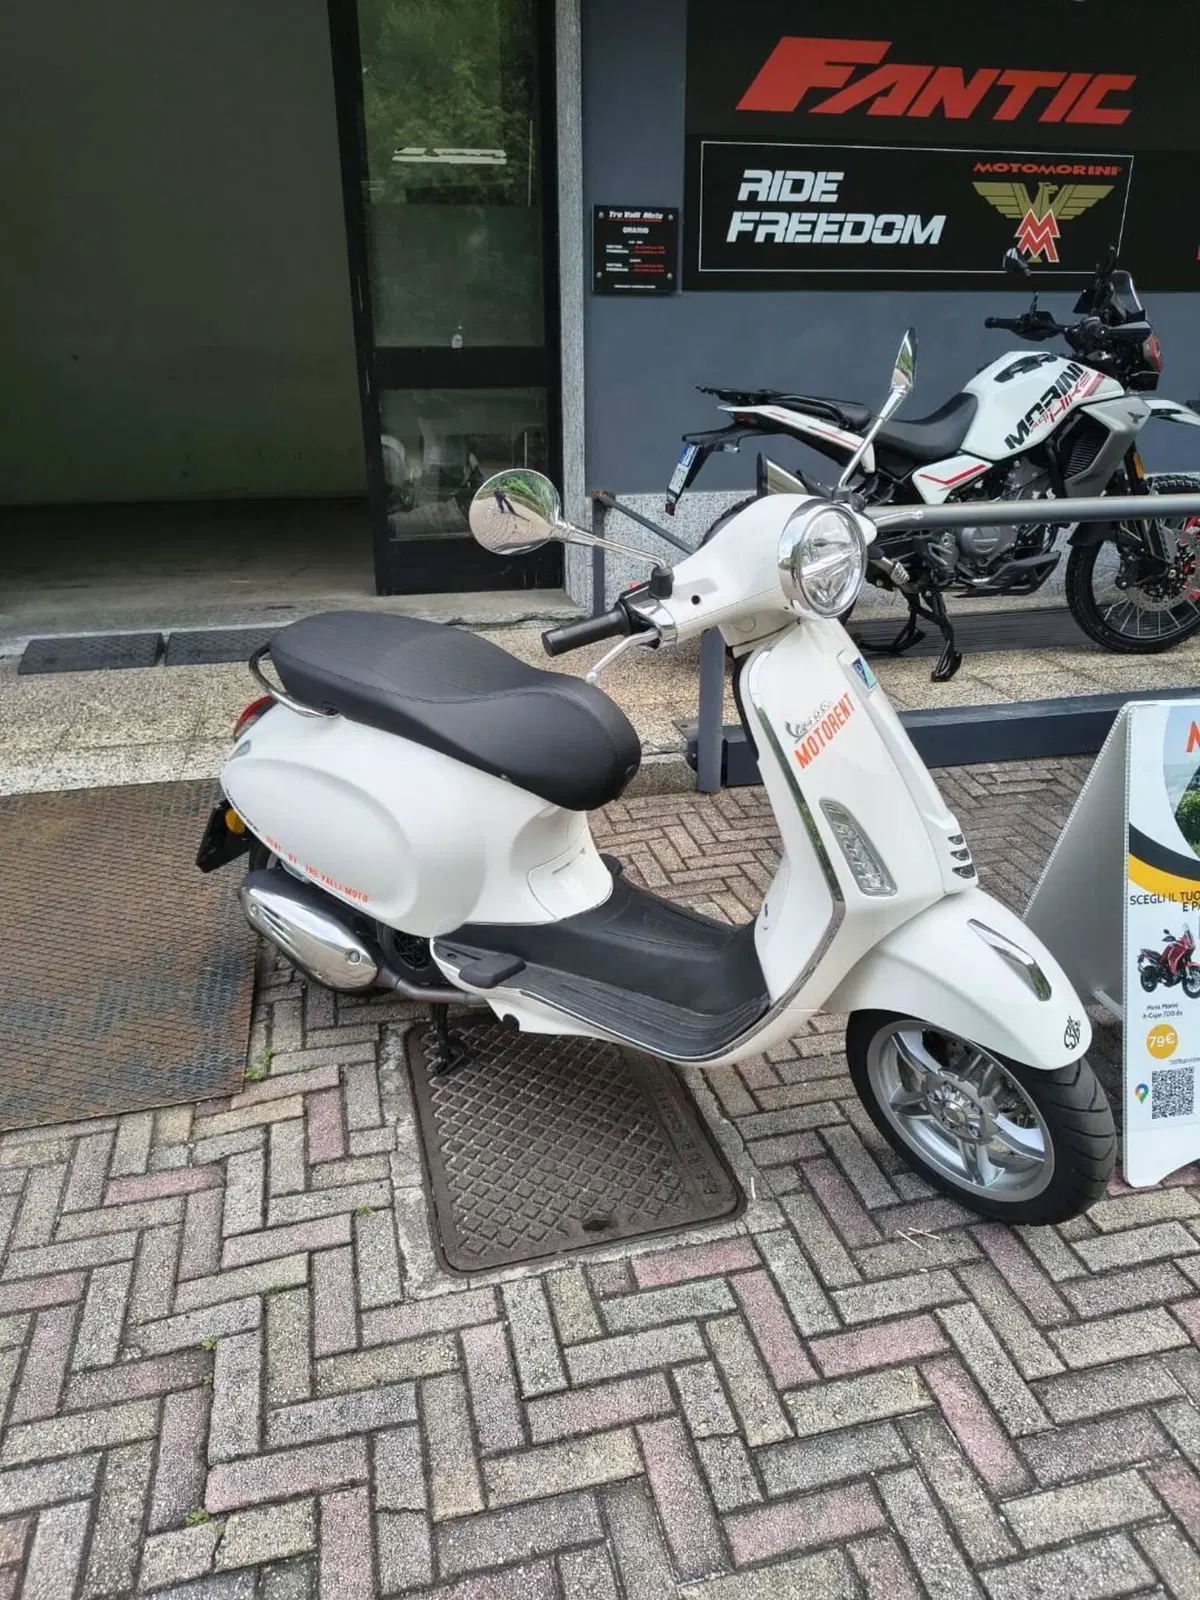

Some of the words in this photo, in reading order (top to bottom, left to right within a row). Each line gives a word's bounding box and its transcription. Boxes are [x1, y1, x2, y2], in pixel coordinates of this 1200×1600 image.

[735, 36, 1138, 125] FANTIC
[738, 169, 845, 203] RIDE
[726, 211, 947, 245] FREEDOM
[1004, 363, 1084, 450] MORINI
[794, 692, 854, 769] MOTORENT
[1130, 894, 1166, 905] SCEGLI
[1183, 902, 1189, 912] E
[1149, 1032, 1175, 1049] 79€
